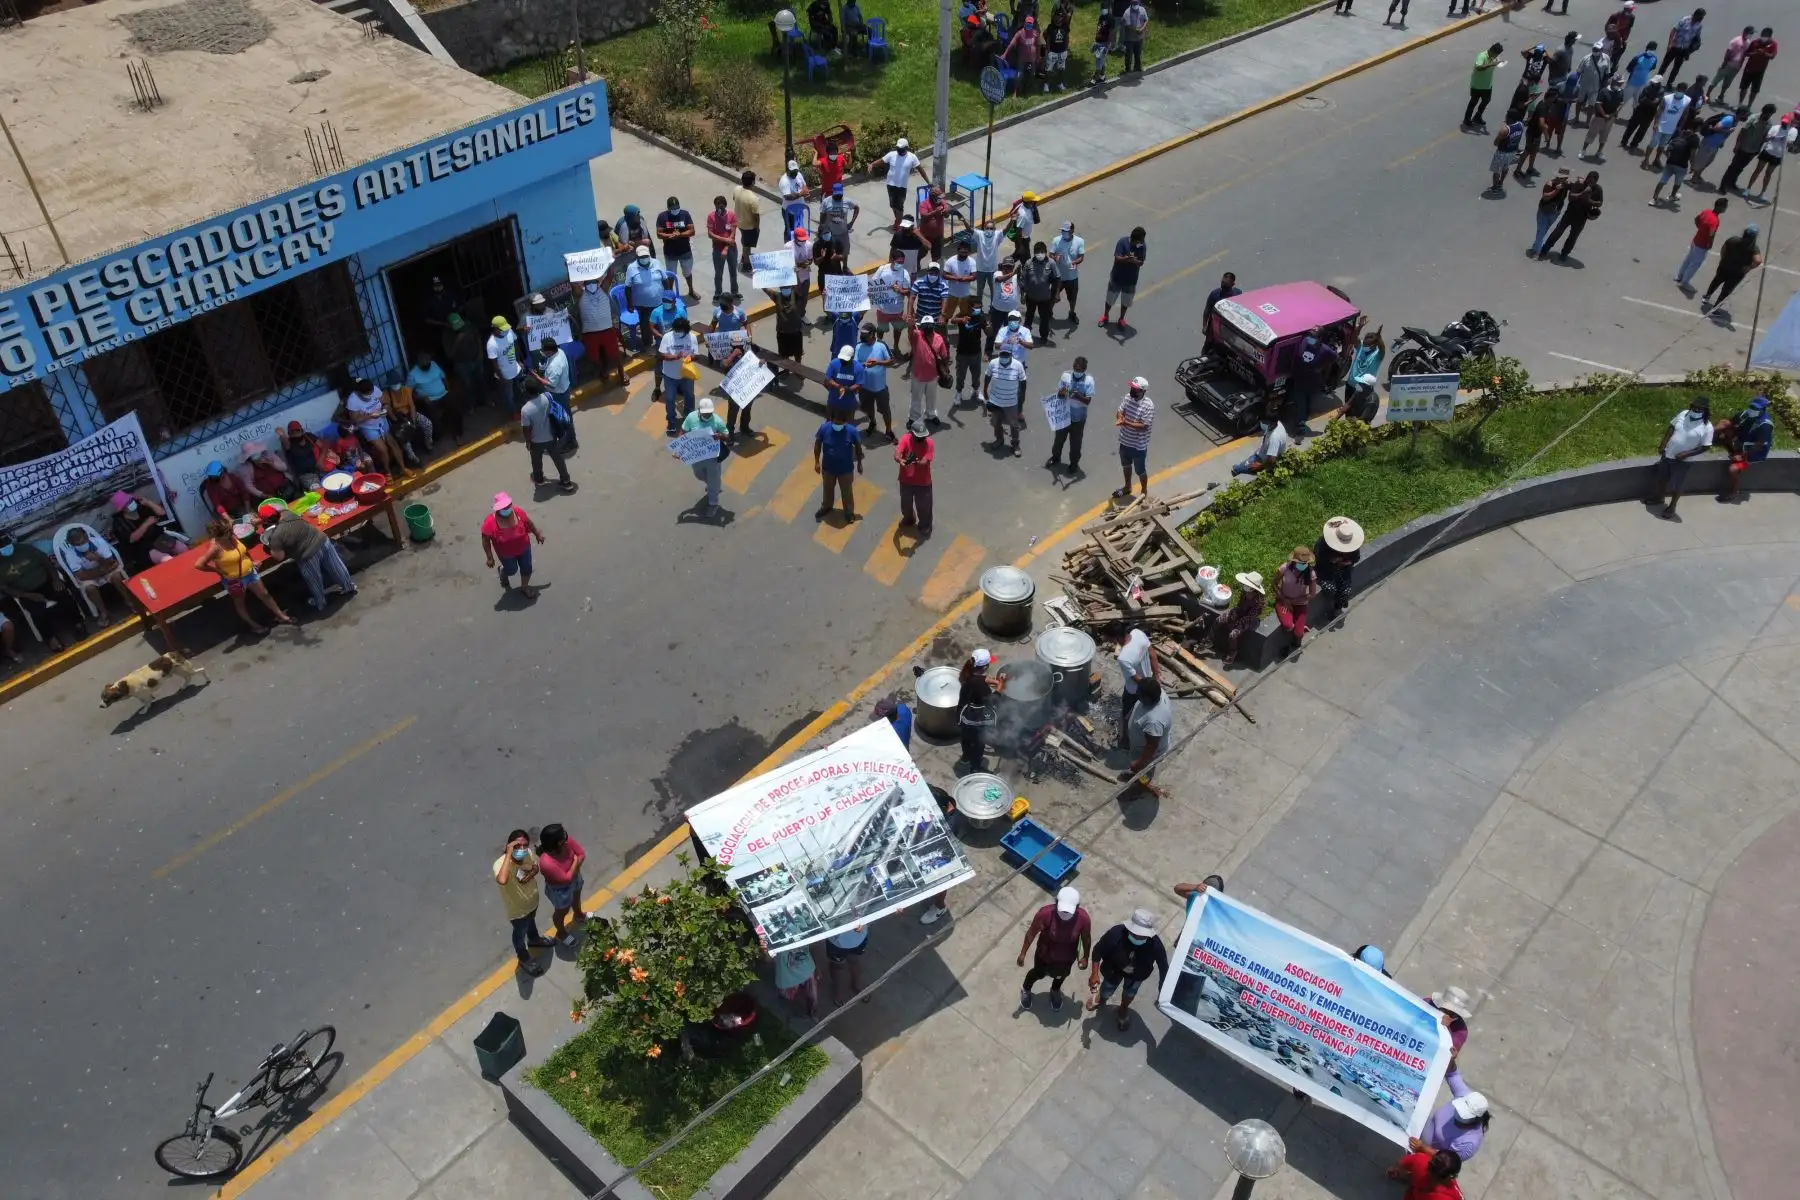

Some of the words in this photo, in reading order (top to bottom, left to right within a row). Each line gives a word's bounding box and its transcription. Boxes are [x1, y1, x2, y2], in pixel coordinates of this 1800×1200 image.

[30, 183, 346, 326] PESCADORES
[354, 91, 597, 208] ARTESANALES
[45, 304, 119, 358] DE
[128, 221, 335, 325] CHANCAY
[46, 356, 74, 374] DE
[83, 331, 136, 360] MAYO
[144, 315, 184, 336] DEL
[189, 291, 238, 317] 2000
[0, 466, 53, 497] ADORES
[55, 431, 138, 474] ARTESANALES
[50, 472, 70, 488] DE
[69, 451, 127, 481] CHANCAY
[213, 422, 272, 454] COMUNICADO
[746, 835, 771, 854] DEL
[771, 815, 815, 843] PUERTO
[835, 780, 887, 812] CHANCAY
[754, 797, 770, 813] DE
[768, 762, 850, 803] PROCESADORAS
[852, 761, 860, 774] Y
[863, 760, 919, 785] FILETERAS
[1193, 948, 1254, 988] EMBARCACION
[1255, 981, 1269, 996] DE
[1270, 989, 1306, 1015] CARGAS
[1307, 1008, 1355, 1039] MENORES
[1355, 1032, 1425, 1072] ARTESANALES
[1204, 937, 1247, 967] MUJERES
[1247, 960, 1307, 998] ARMADORAS
[1309, 990, 1317, 1001] Y
[1316, 995, 1407, 1045] EMPRENDEDORAS
[1408, 1037, 1425, 1053] DE
[1284, 962, 1342, 998] ASOCIACION
[1240, 990, 1257, 1008] DEL
[1260, 1002, 1297, 1026] PUERTO
[1296, 1019, 1311, 1035] DE
[1311, 1029, 1358, 1058] CHANCAY
